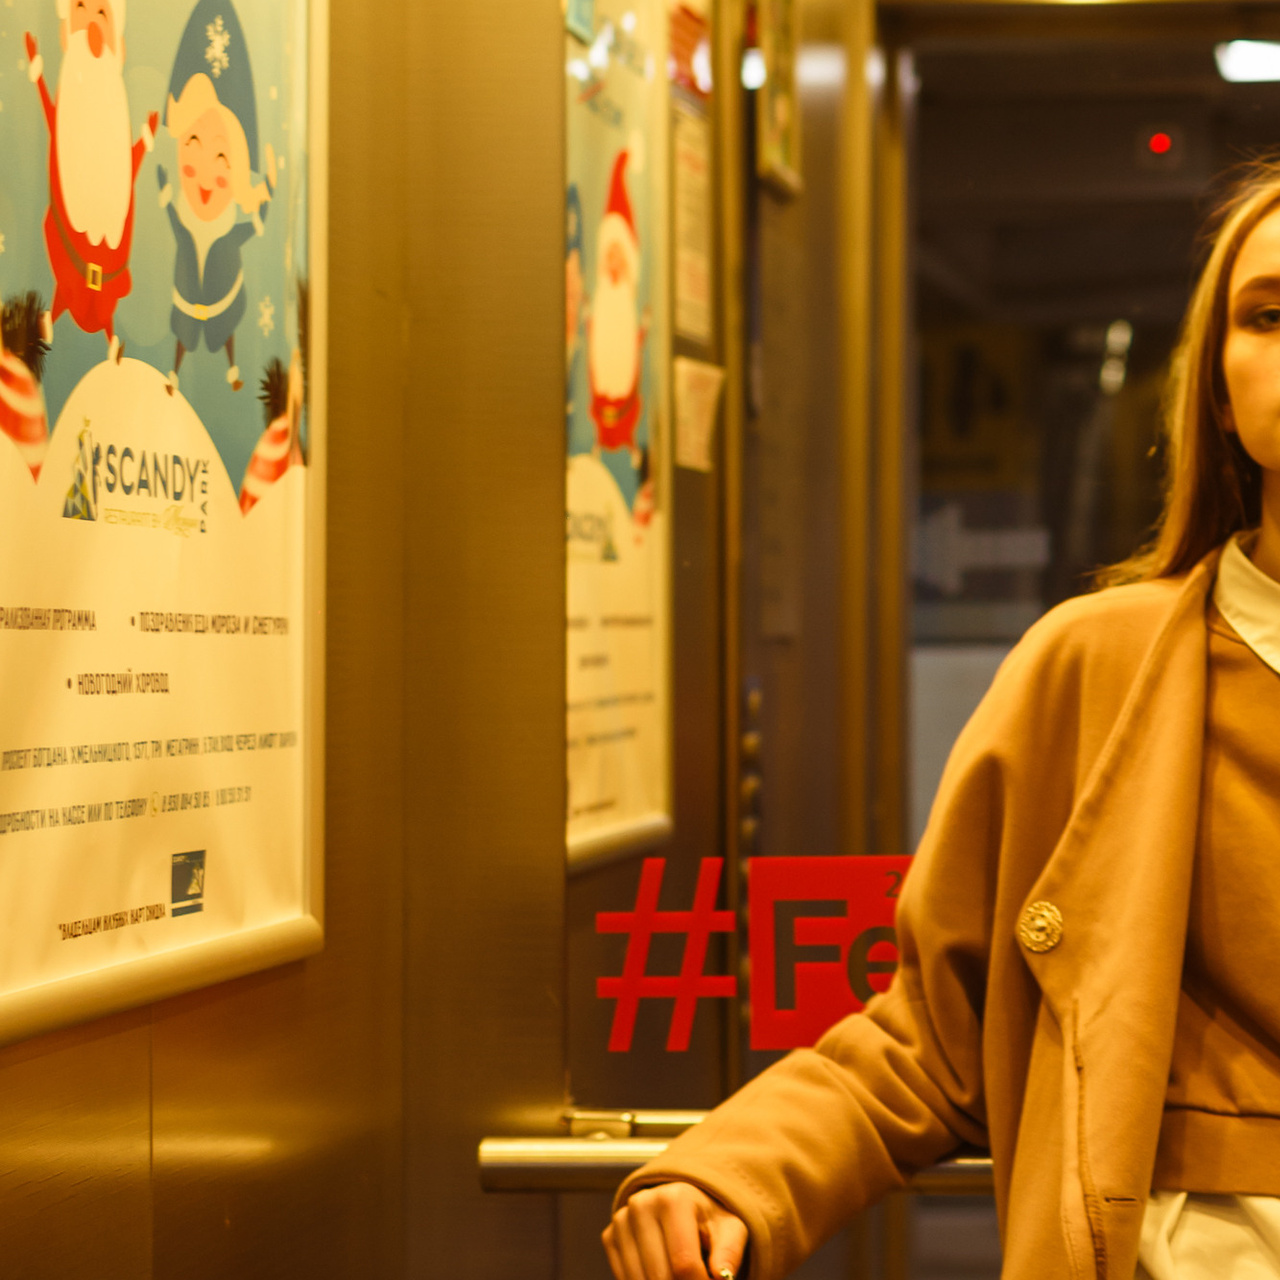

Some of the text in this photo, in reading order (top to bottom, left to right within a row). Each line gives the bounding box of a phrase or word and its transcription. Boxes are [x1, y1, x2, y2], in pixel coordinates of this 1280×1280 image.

[104, 443, 200, 503] SCANDY
[77, 668, 169, 694] НОВОГОДНИЙ ХОРОВОД
[47, 807, 59, 828] НА
[61, 805, 85, 827] КАССЕ
